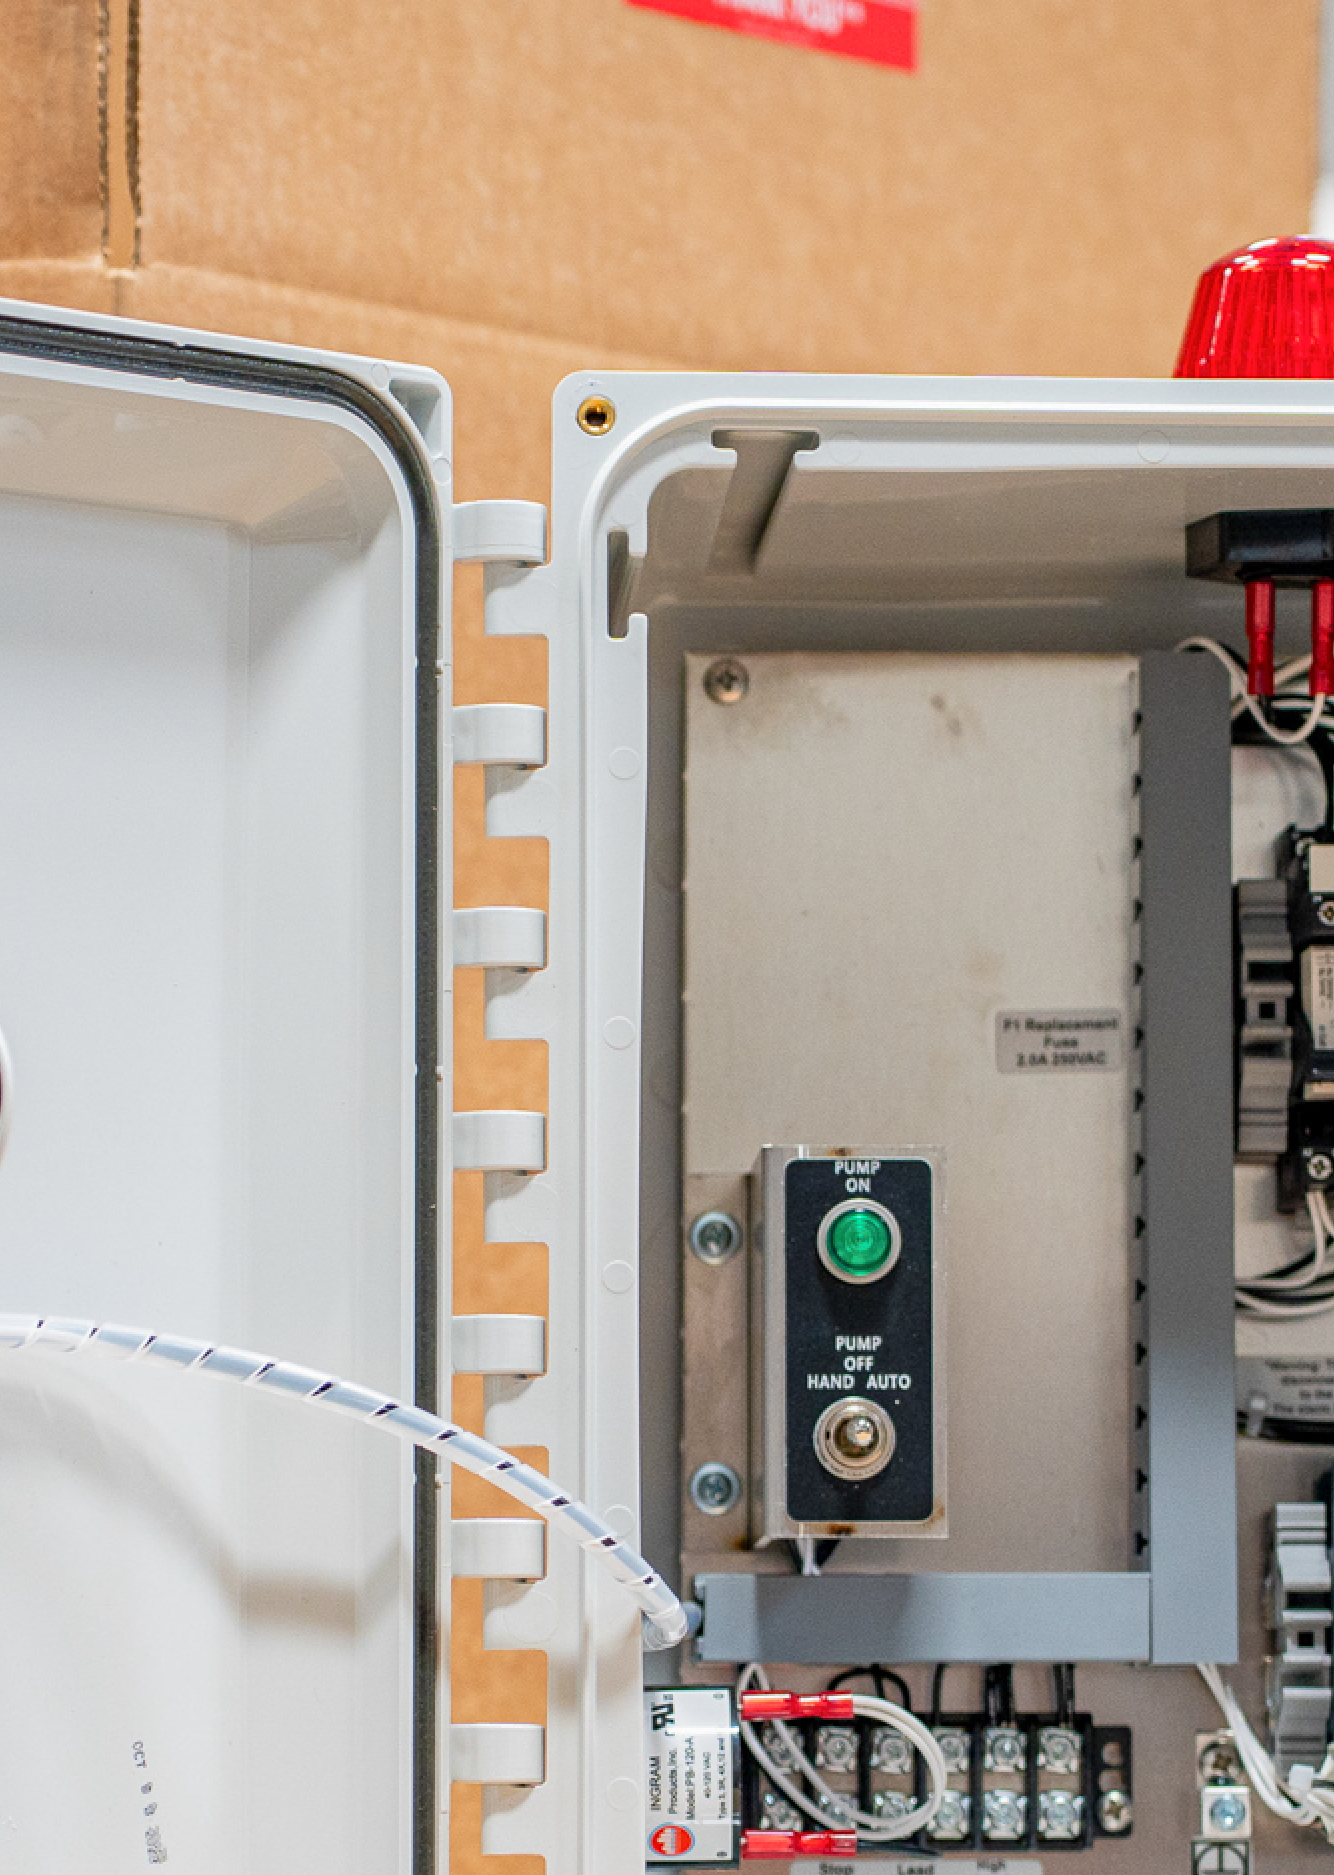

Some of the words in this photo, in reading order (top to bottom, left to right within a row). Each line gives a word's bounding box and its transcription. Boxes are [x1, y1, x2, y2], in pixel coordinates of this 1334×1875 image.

[1024, 1017, 1119, 1032] Replacement
[1043, 1035, 1078, 1048] Fuse
[834, 1159, 882, 1175] PUMP
[845, 1177, 872, 1193] ON
[835, 1335, 883, 1351] PUMP
[843, 1355, 875, 1372] OFF
[806, 1373, 856, 1390] HAND
[866, 1373, 912, 1390] AUTO
[649, 1755, 662, 1811] INGRAM
